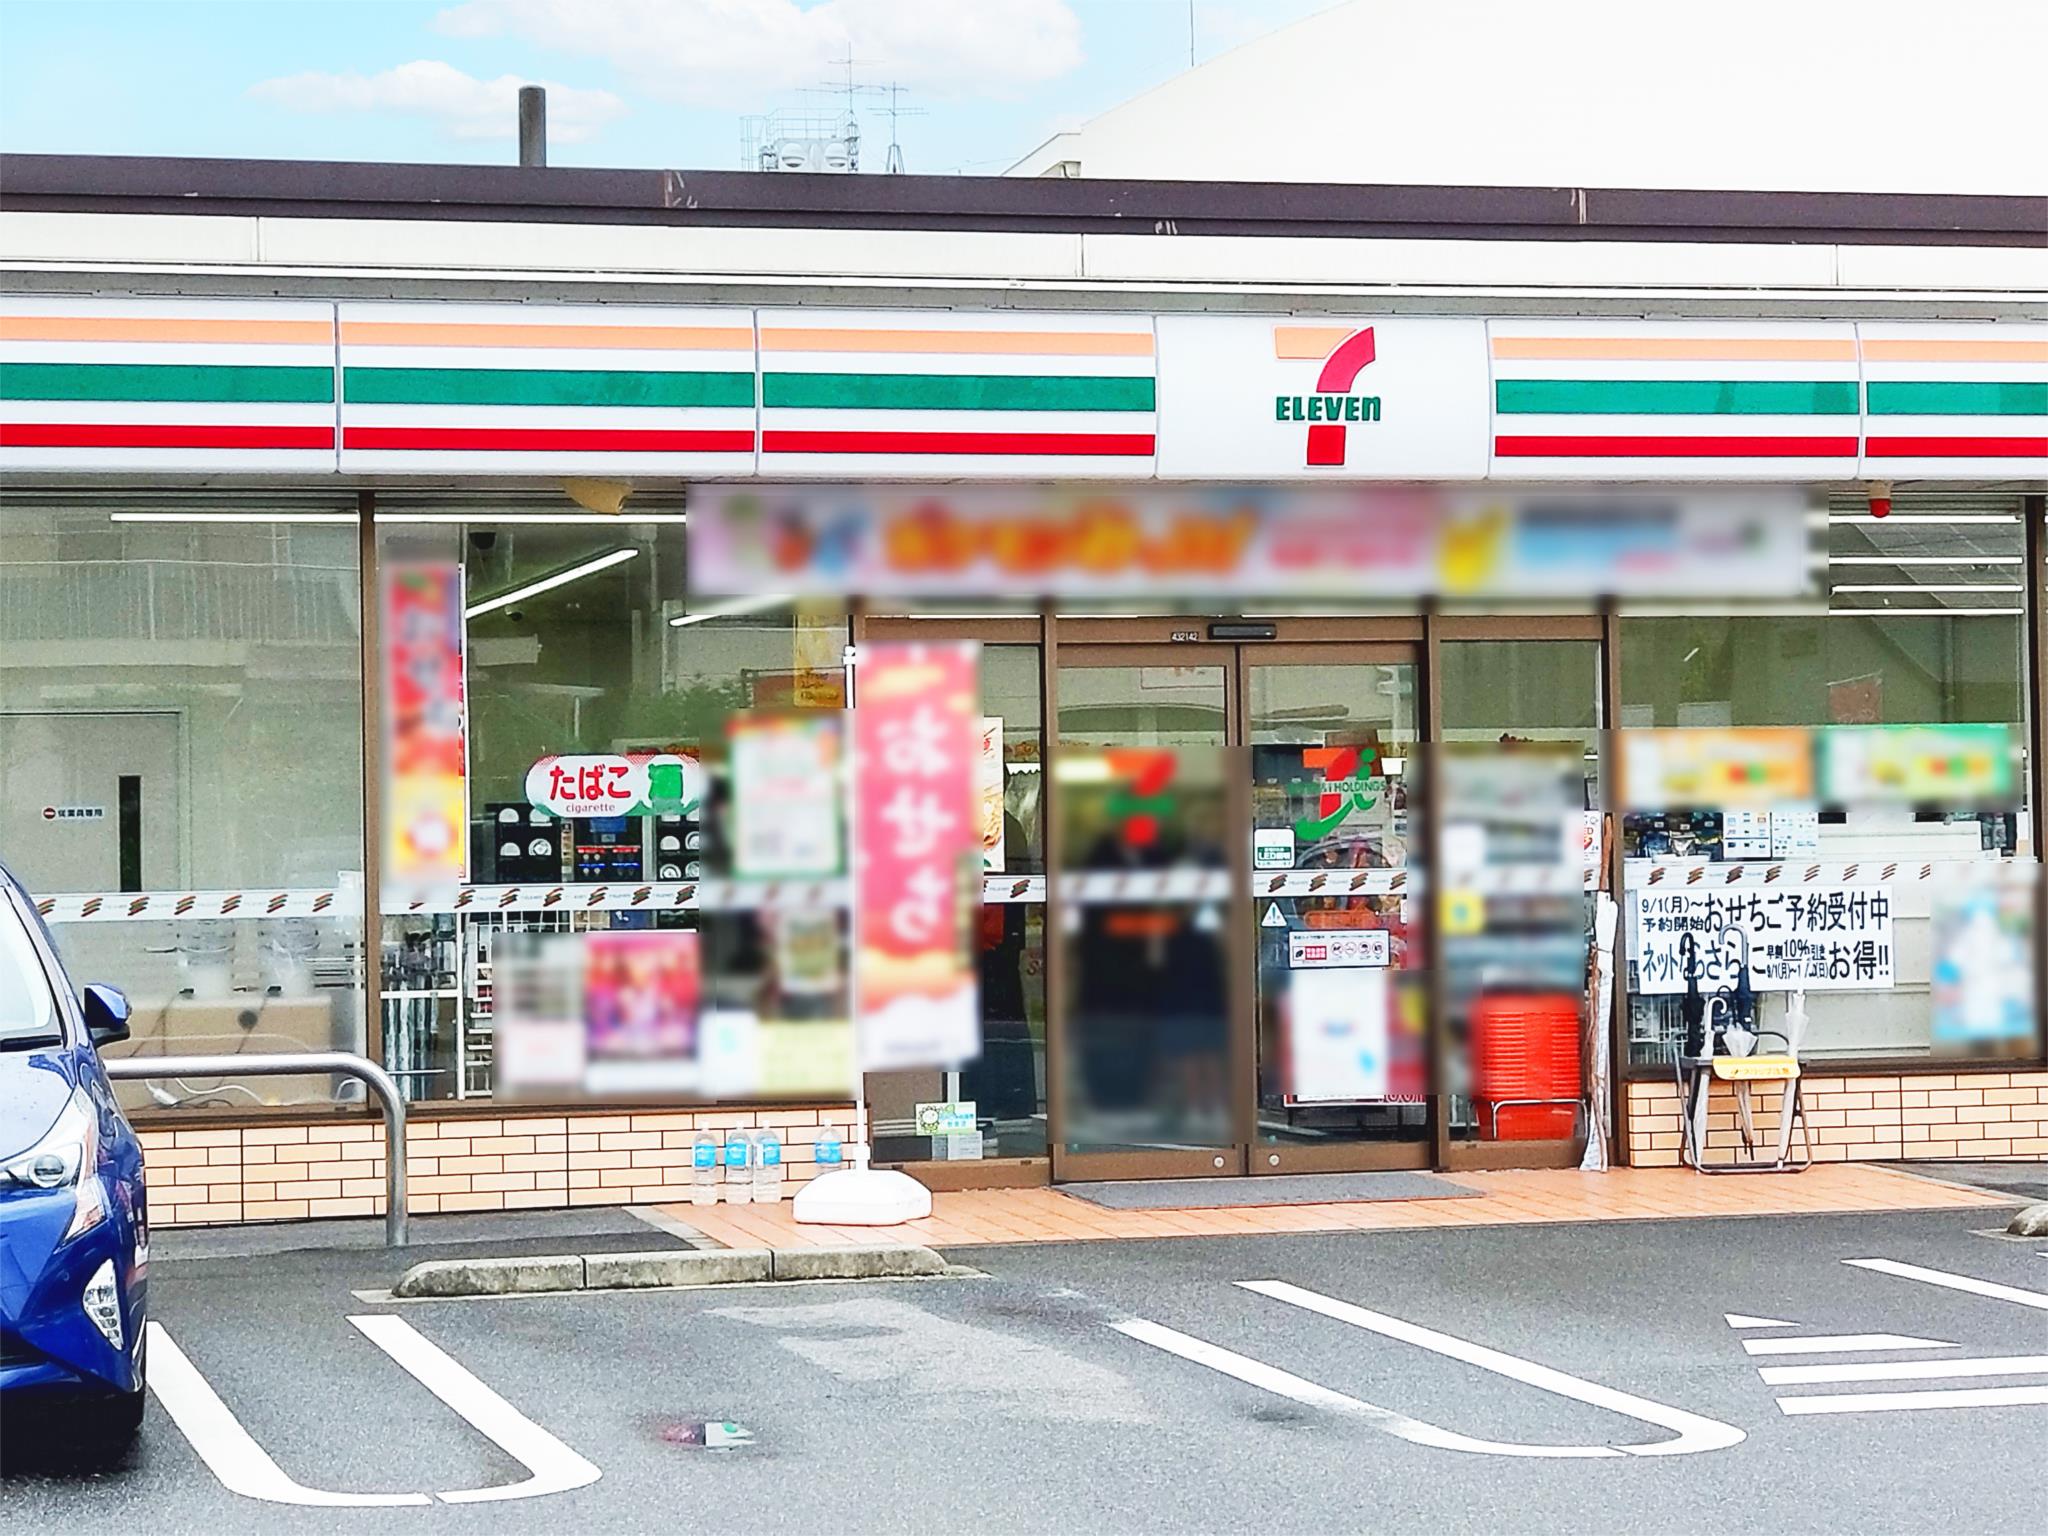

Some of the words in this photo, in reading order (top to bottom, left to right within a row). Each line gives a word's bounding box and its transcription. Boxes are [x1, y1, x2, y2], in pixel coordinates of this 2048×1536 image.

[550, 764, 631, 801] たばこ
[1334, 781, 1387, 793] HOLDINGS
[565, 802, 615, 813] cigarette
[1641, 916, 1704, 933] 予約開始
[1704, 890, 1889, 933] おせちご予約受付中
[1829, 940, 1889, 981] お得!!
